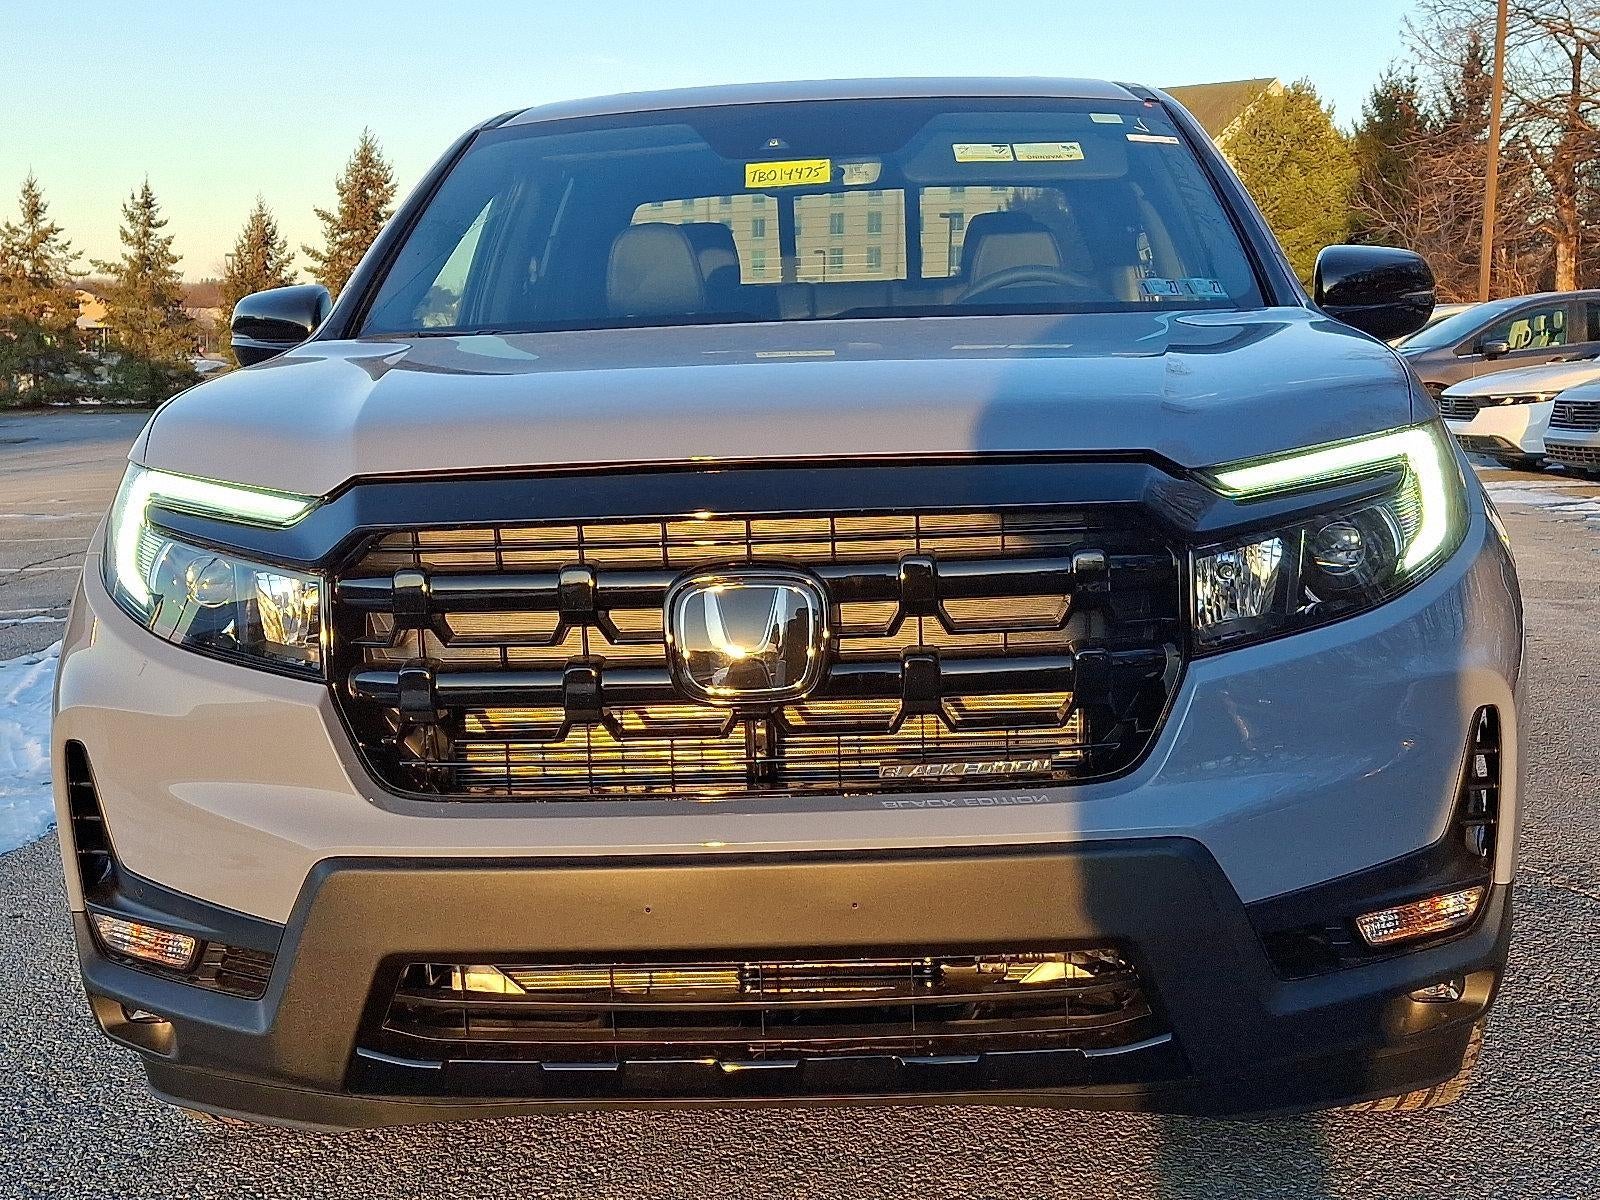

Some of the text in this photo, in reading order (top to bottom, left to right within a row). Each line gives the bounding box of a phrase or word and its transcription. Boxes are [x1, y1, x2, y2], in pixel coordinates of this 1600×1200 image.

[1165, 280, 1180, 294] 27
[1208, 280, 1223, 294] 27
[879, 760, 1052, 778] BLACK EDITION
